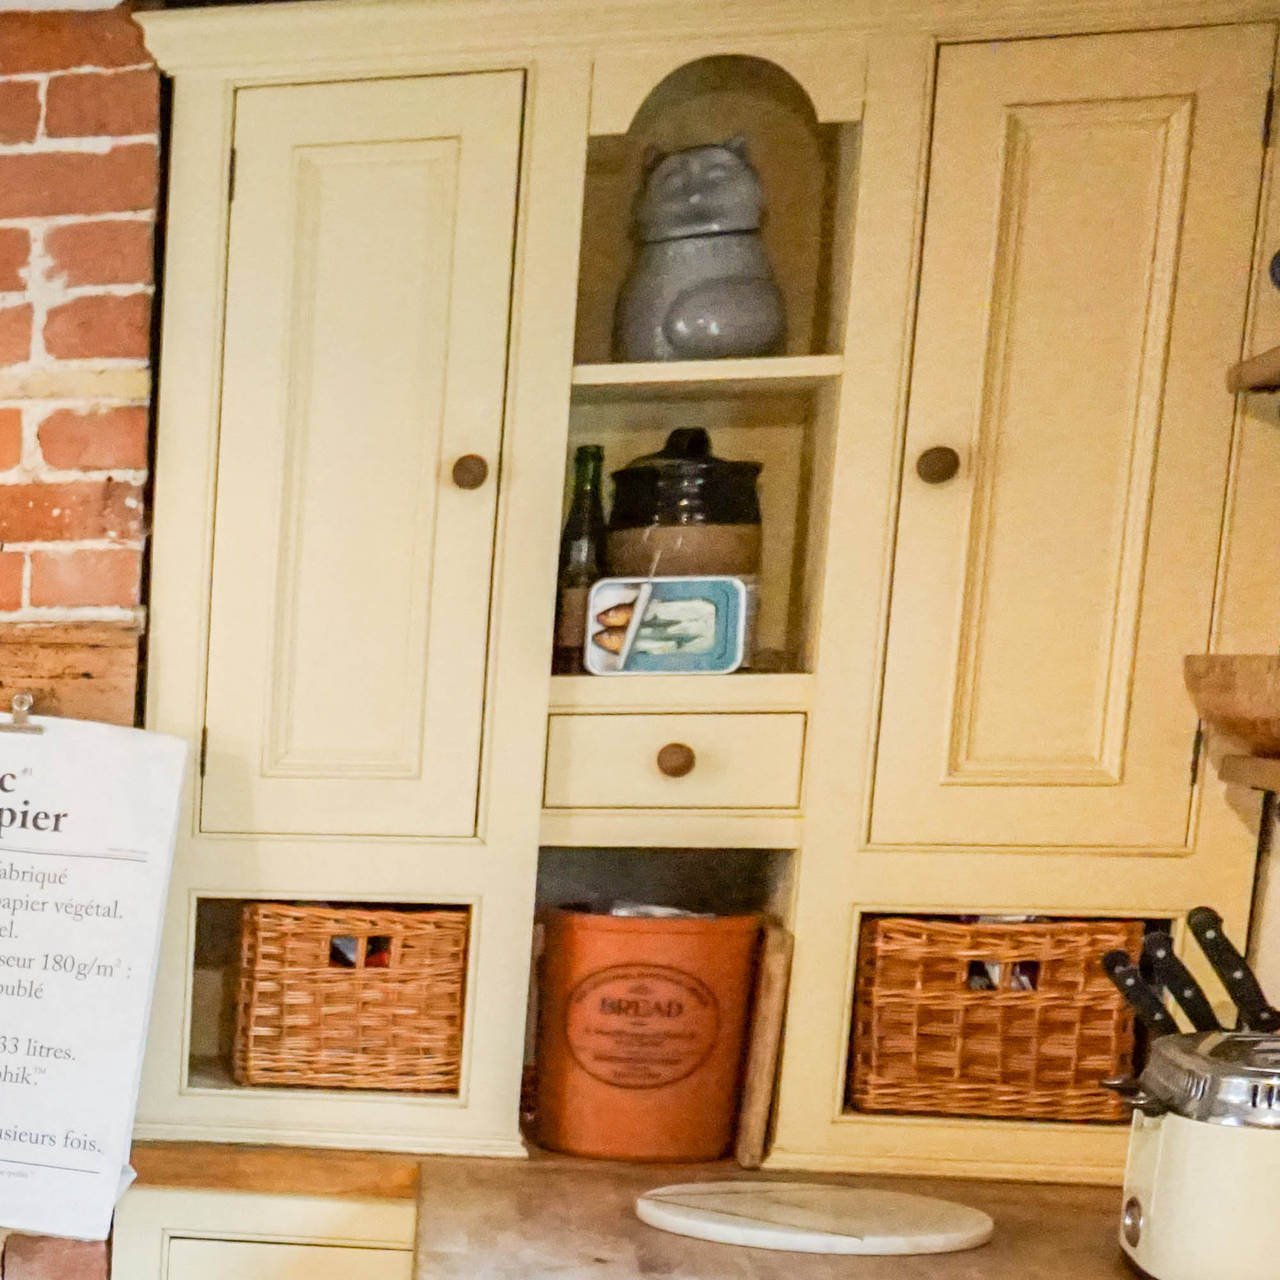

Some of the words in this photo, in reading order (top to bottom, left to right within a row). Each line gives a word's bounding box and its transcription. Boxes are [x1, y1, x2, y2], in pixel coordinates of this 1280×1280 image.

[53, 898, 124, 921] végétal.
[600, 998, 684, 1017] BREAD
[27, 1037, 76, 1062] litres.
[62, 1130, 103, 1154] fois.
